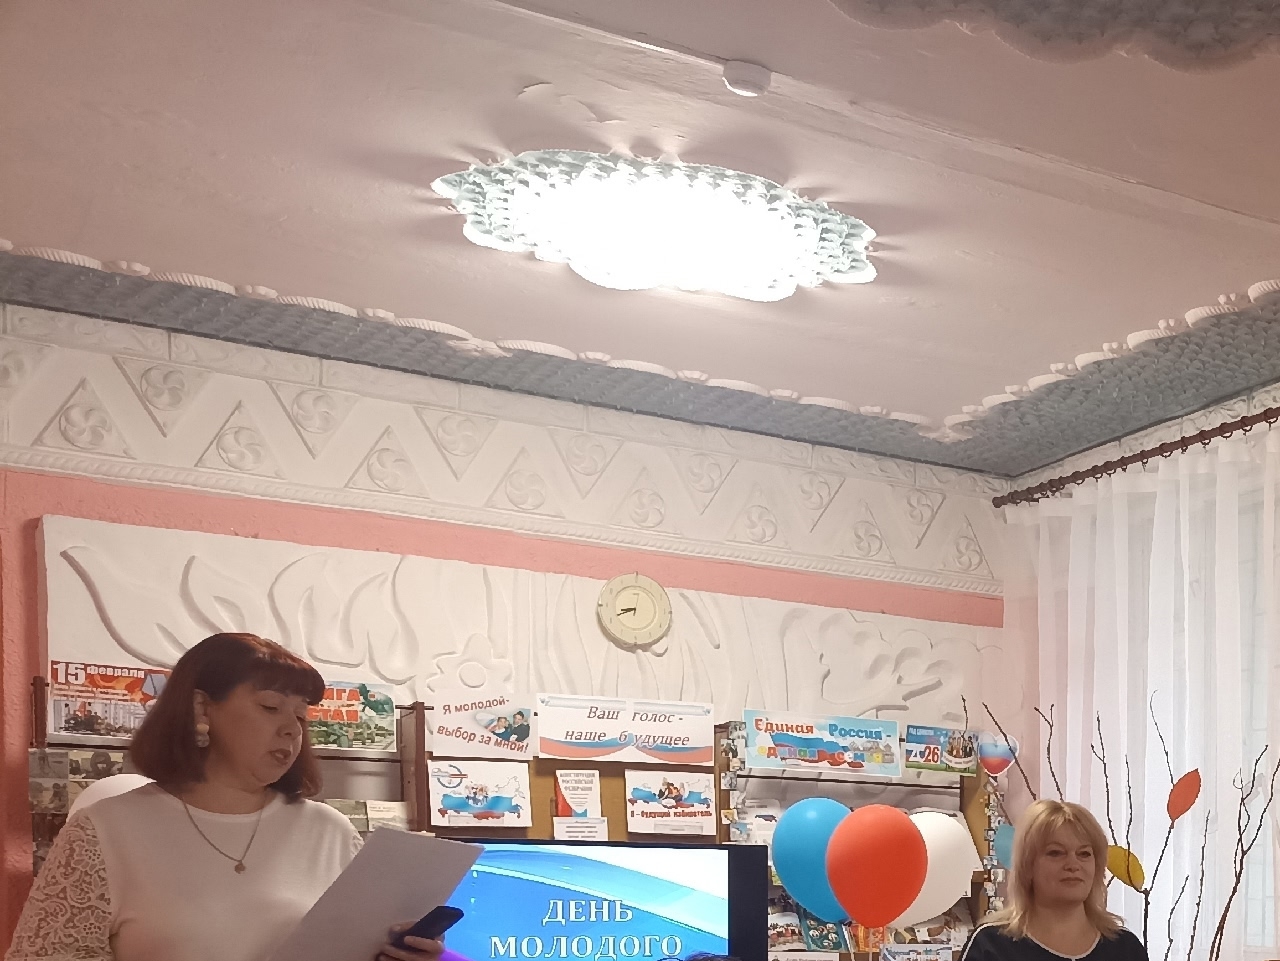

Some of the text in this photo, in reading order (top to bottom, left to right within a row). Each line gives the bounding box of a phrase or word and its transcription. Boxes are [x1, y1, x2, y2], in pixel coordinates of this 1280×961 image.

[53, 663, 145, 685] 15 февраля
[322, 687, 361, 701] ИГА
[443, 704, 452, 715] Я
[586, 705, 621, 720] Ваш
[631, 711, 675, 723] голос
[436, 725, 530, 754] выбор за мной!
[564, 729, 607, 742] наше
[754, 718, 814, 734] Единая
[828, 723, 883, 741] Россия
[541, 899, 634, 927] ДЕНЬ
[489, 935, 683, 961] МОЛОДОГО
